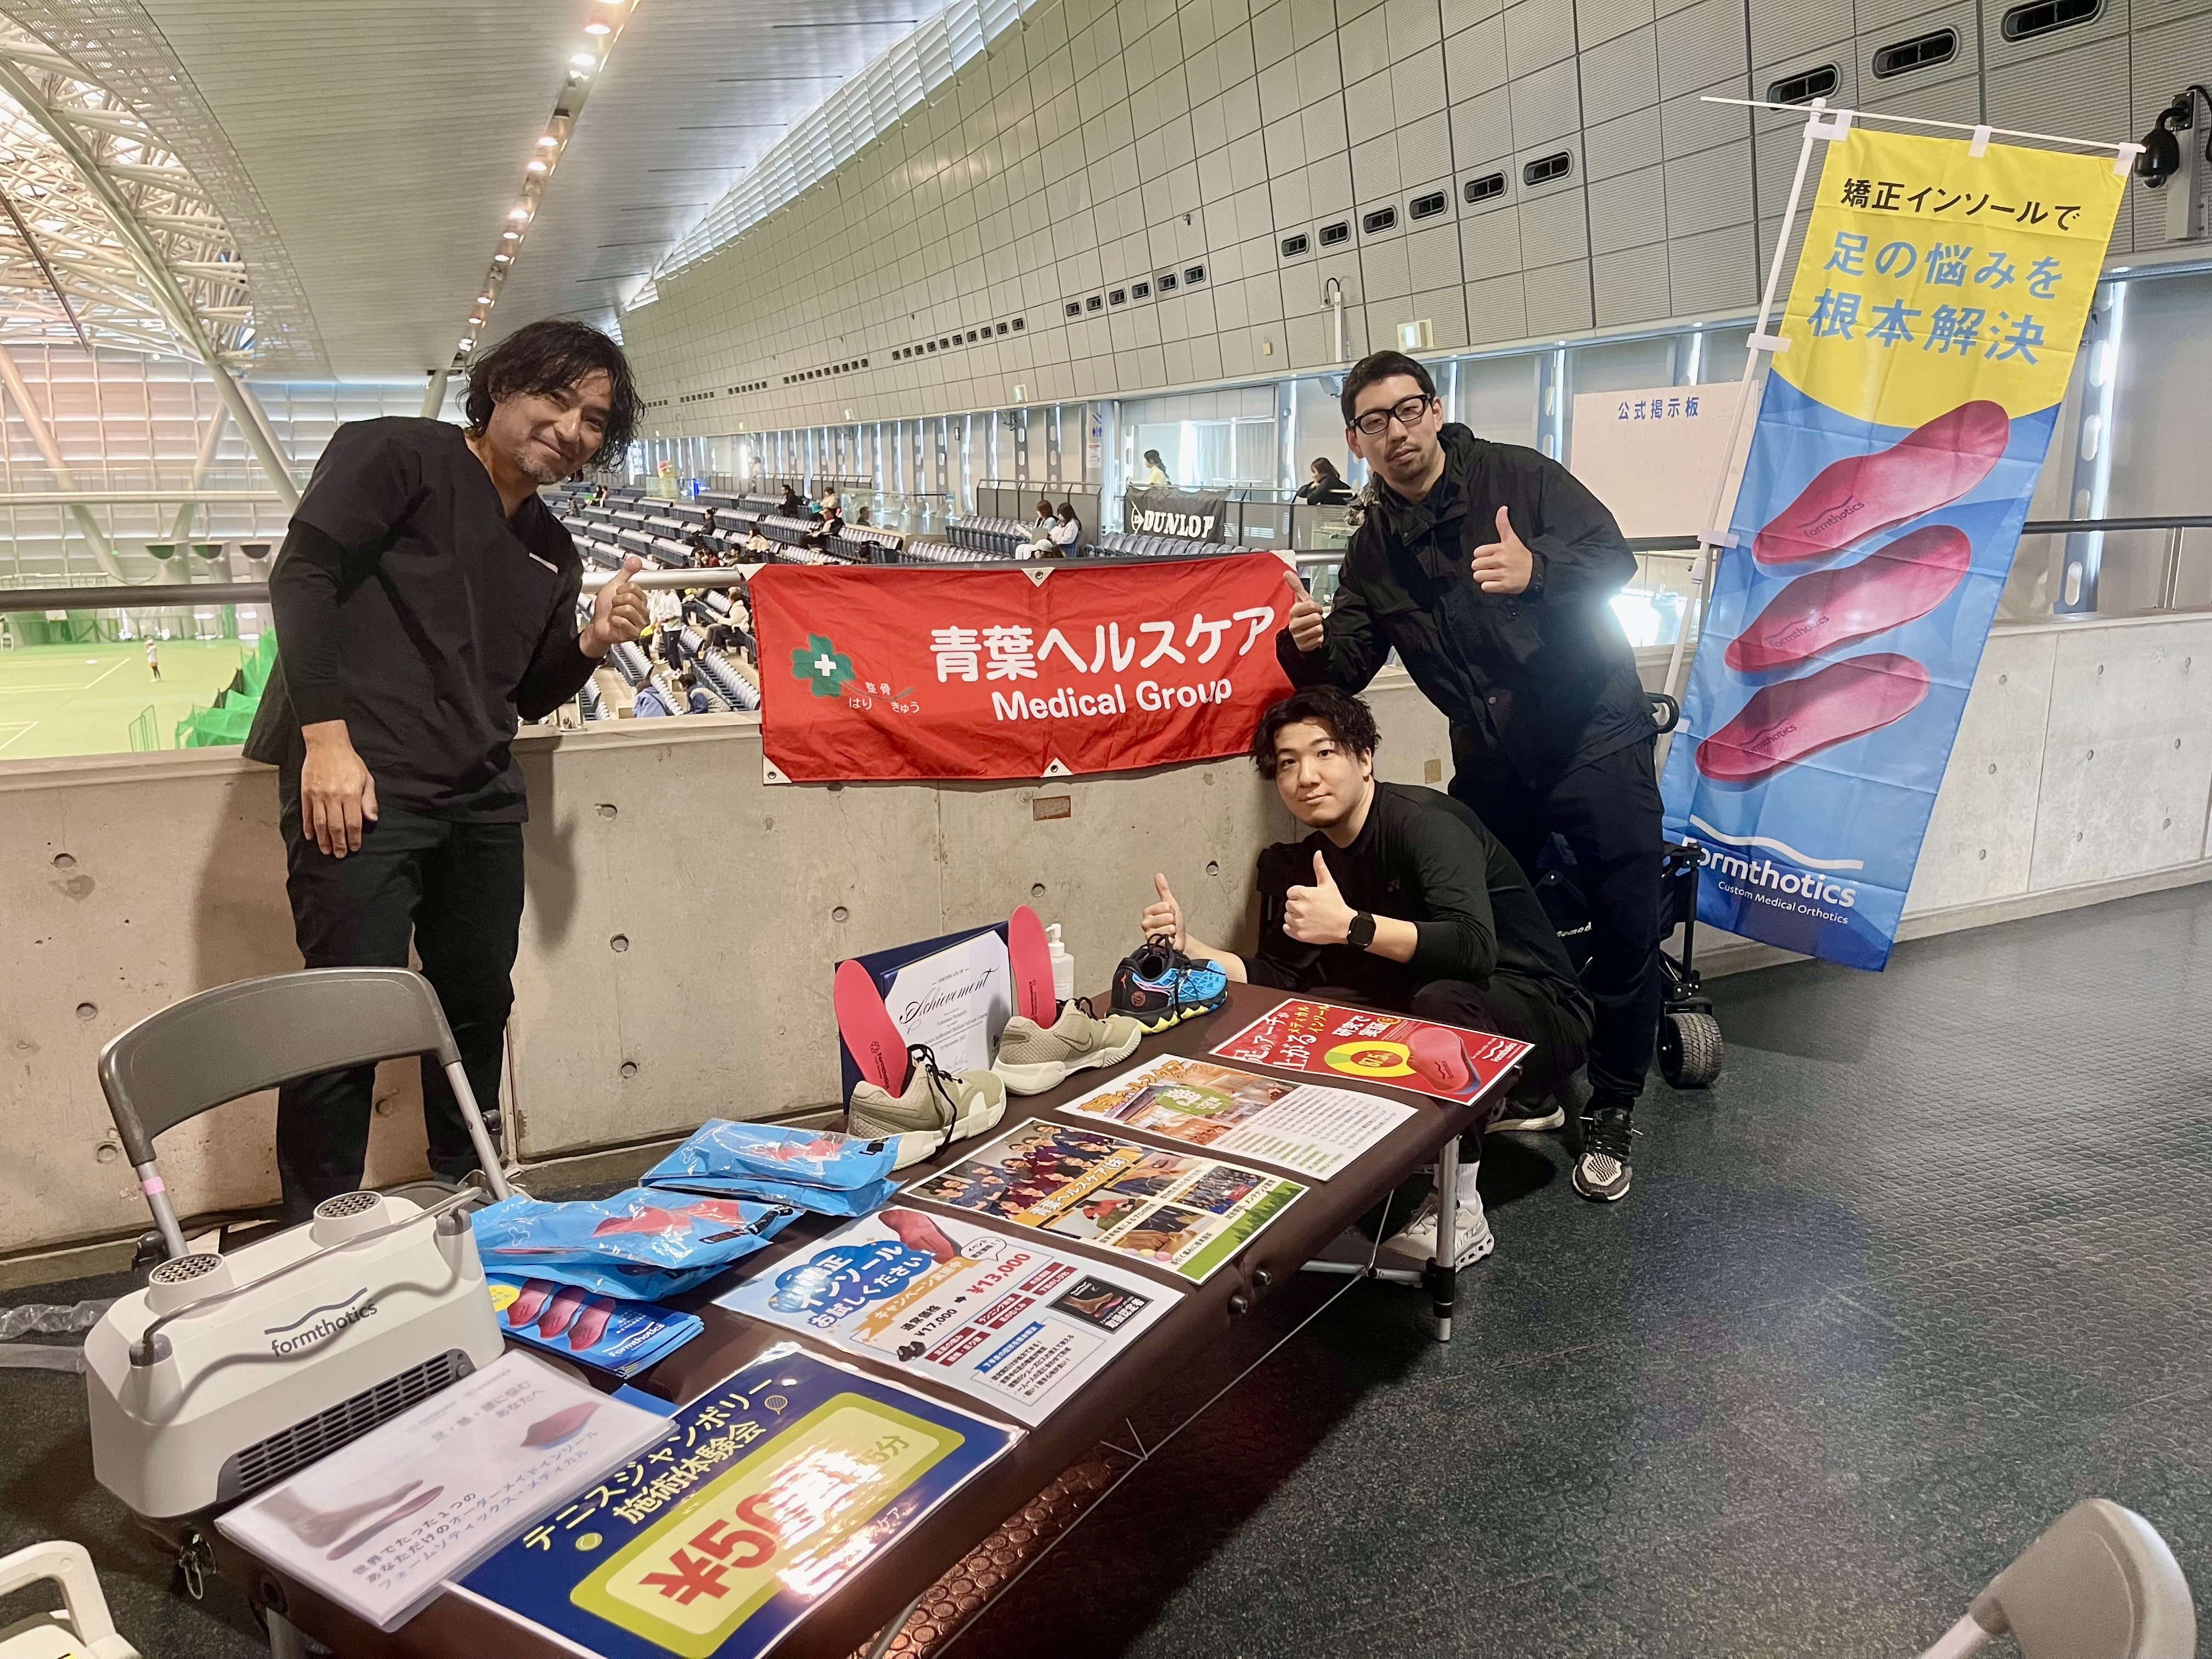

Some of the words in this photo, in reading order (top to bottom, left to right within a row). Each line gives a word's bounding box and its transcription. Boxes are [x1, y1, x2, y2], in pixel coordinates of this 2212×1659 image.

[1840, 177, 2081, 232] 矯正インソールで
[1824, 230, 2064, 300] 足の悩みを
[1807, 287, 2045, 365] 根本解決
[1618, 397, 1699, 420] 公式掲示板
[1143, 510, 1215, 538] DUNLOP
[1804, 500, 1865, 538] formthotics
[929, 606, 1276, 683] 青葉ヘルスケア
[849, 697, 872, 710] はり
[890, 701, 919, 713] きゅう
[991, 686, 1127, 722] Medical
[1136, 679, 1233, 714] Group
[1718, 881, 1753, 900] Custom
[1755, 893, 1796, 911] Medical
[1797, 904, 1849, 925] Orthotics
[899, 966, 1000, 1034] Achievement
[793, 1243, 908, 1312] インソール
[806, 1249, 940, 1328] お試しください！
[964, 1252, 1035, 1295] ¥13,000
[271, 1301, 377, 1357] formthotics
[899, 1304, 943, 1331] 通常価格
[913, 1308, 959, 1337] ¥17,000
[609, 1323, 665, 1357] Formthotics
[523, 1379, 772, 1551] テニスジャンボリー
[613, 1420, 766, 1525] 施術体験会
